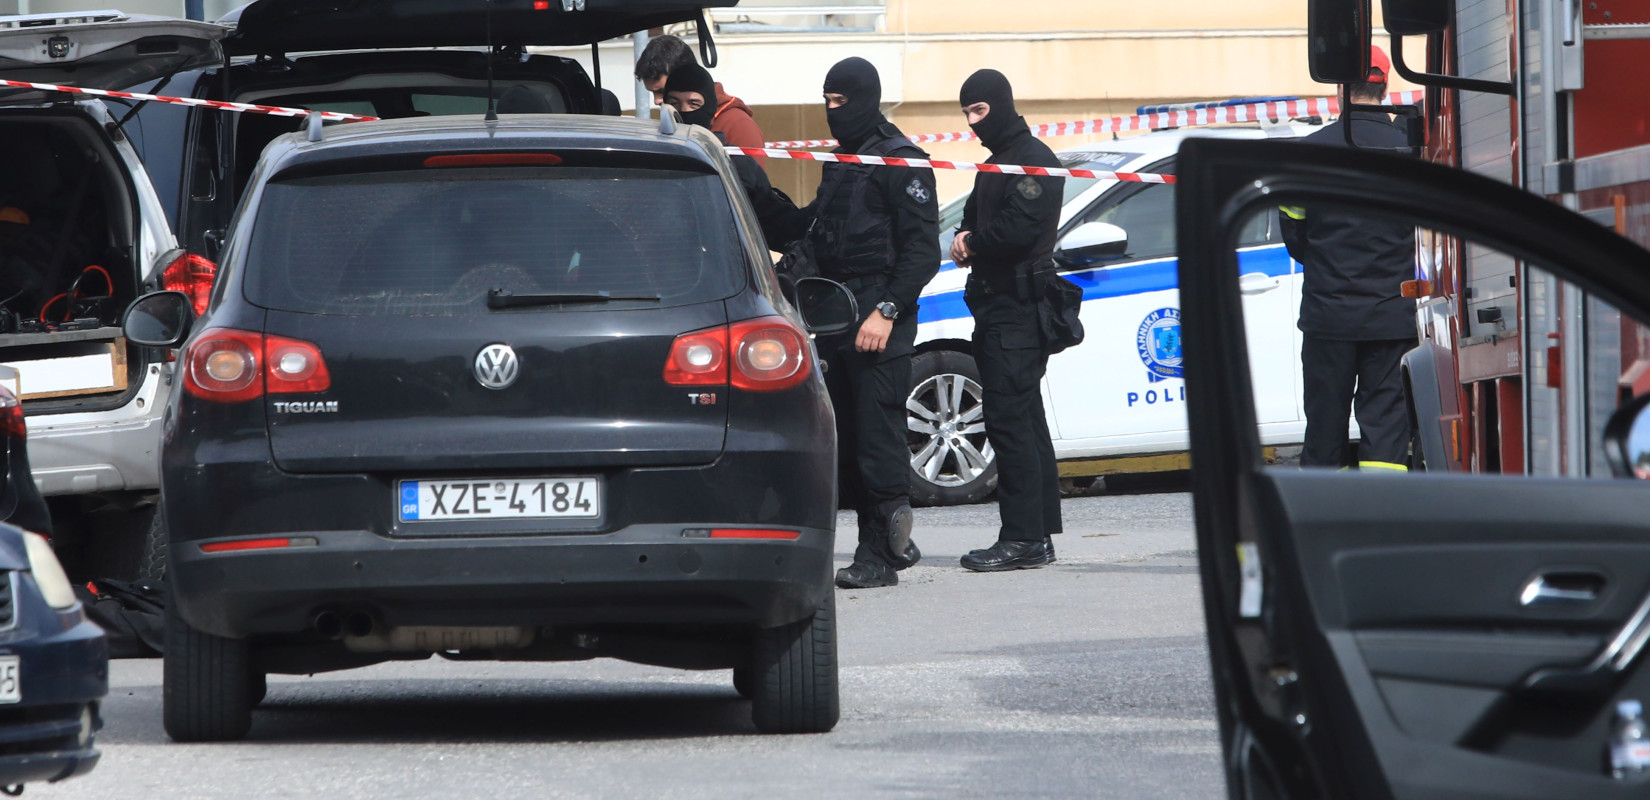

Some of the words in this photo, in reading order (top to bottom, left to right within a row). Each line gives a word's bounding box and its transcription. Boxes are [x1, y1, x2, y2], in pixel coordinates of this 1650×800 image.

[687, 393, 716, 405] TSI
[273, 401, 338, 413] TIGUAN
[402, 505, 417, 514] GR
